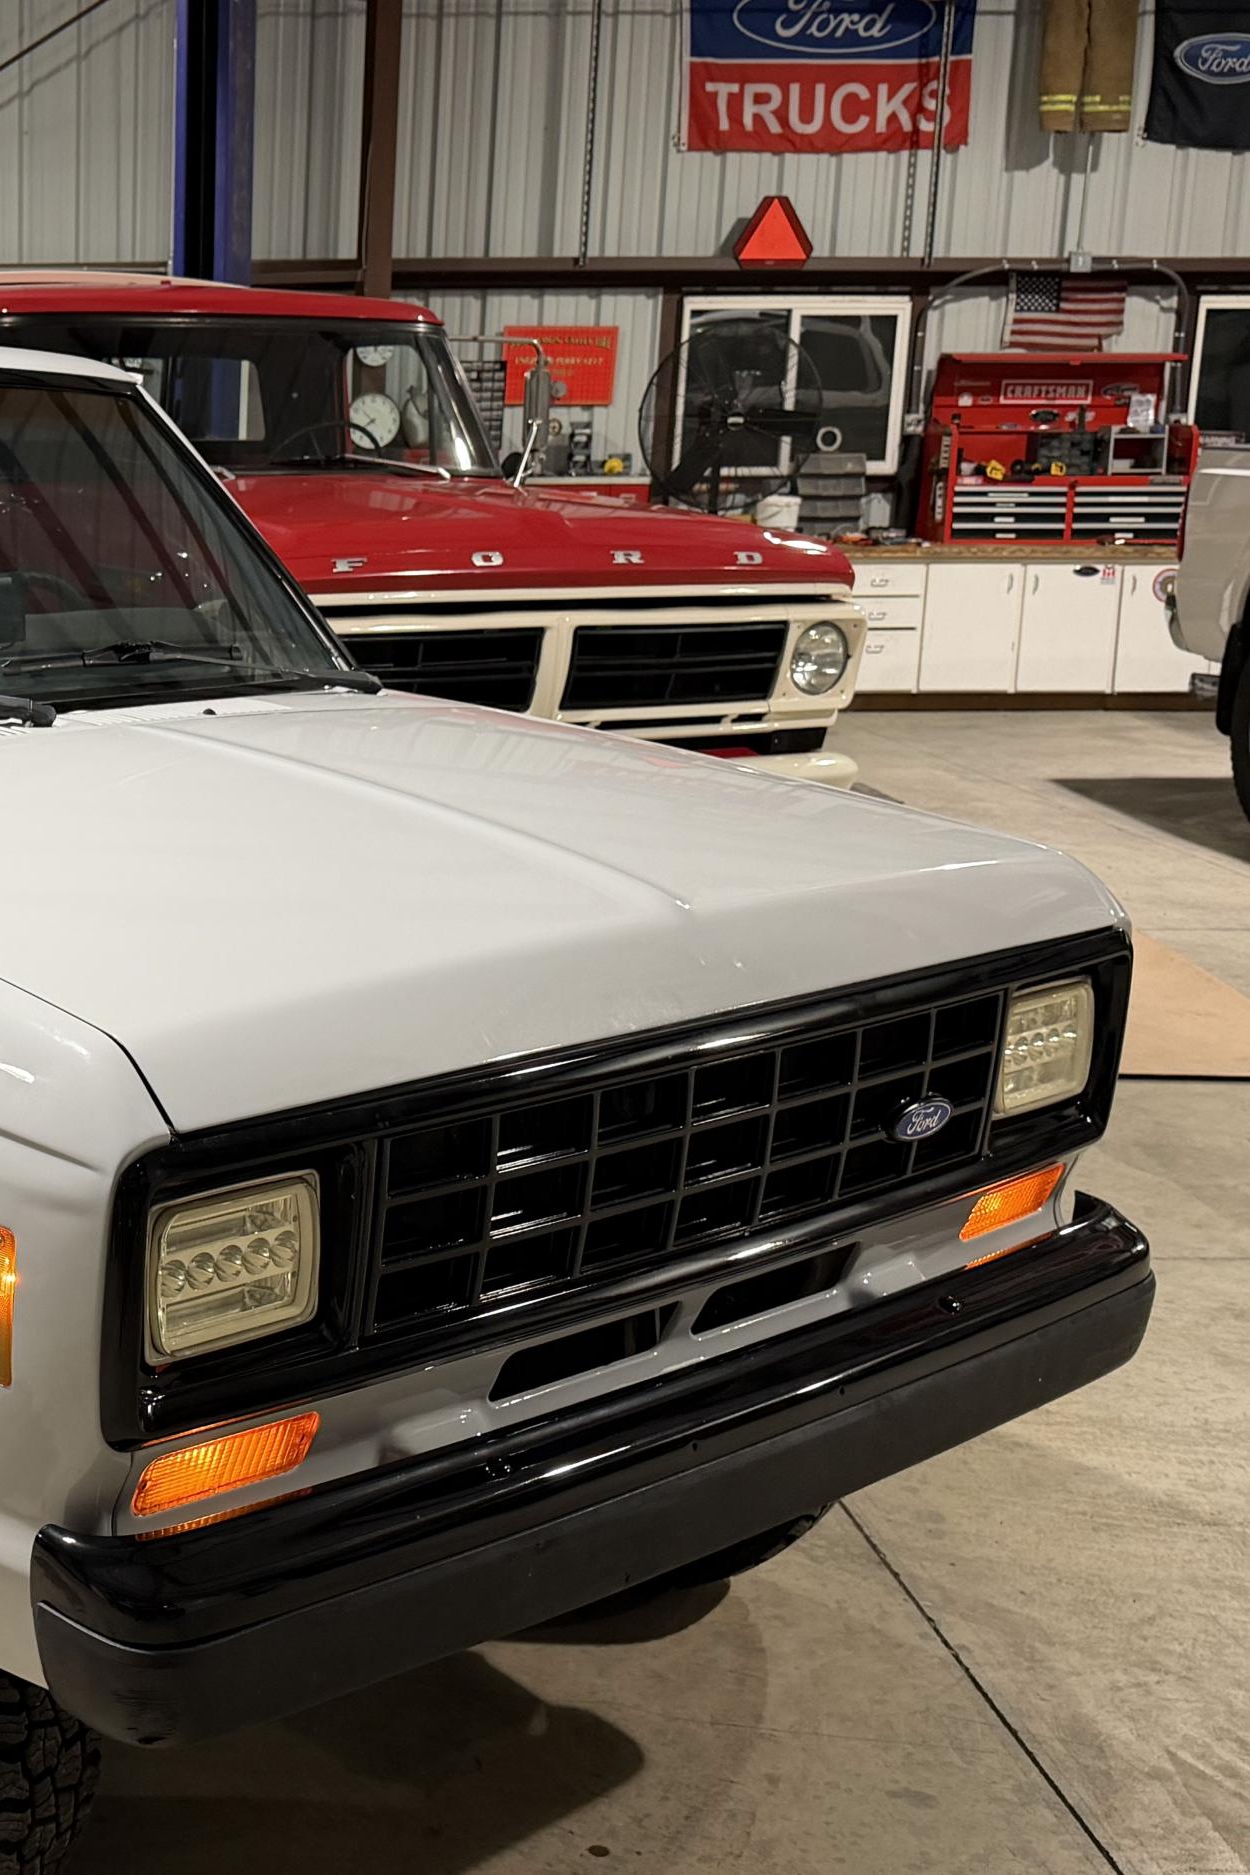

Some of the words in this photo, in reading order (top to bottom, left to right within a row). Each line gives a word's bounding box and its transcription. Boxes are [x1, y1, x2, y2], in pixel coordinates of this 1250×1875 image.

[775, 0, 898, 38] Ford
[1197, 43, 1250, 73] Ford
[704, 81, 951, 135] TRUCKS
[1006, 385, 1087, 399] CRAFTSMAN
[331, 550, 764, 573] FORD
[907, 1106, 942, 1135] Ford
